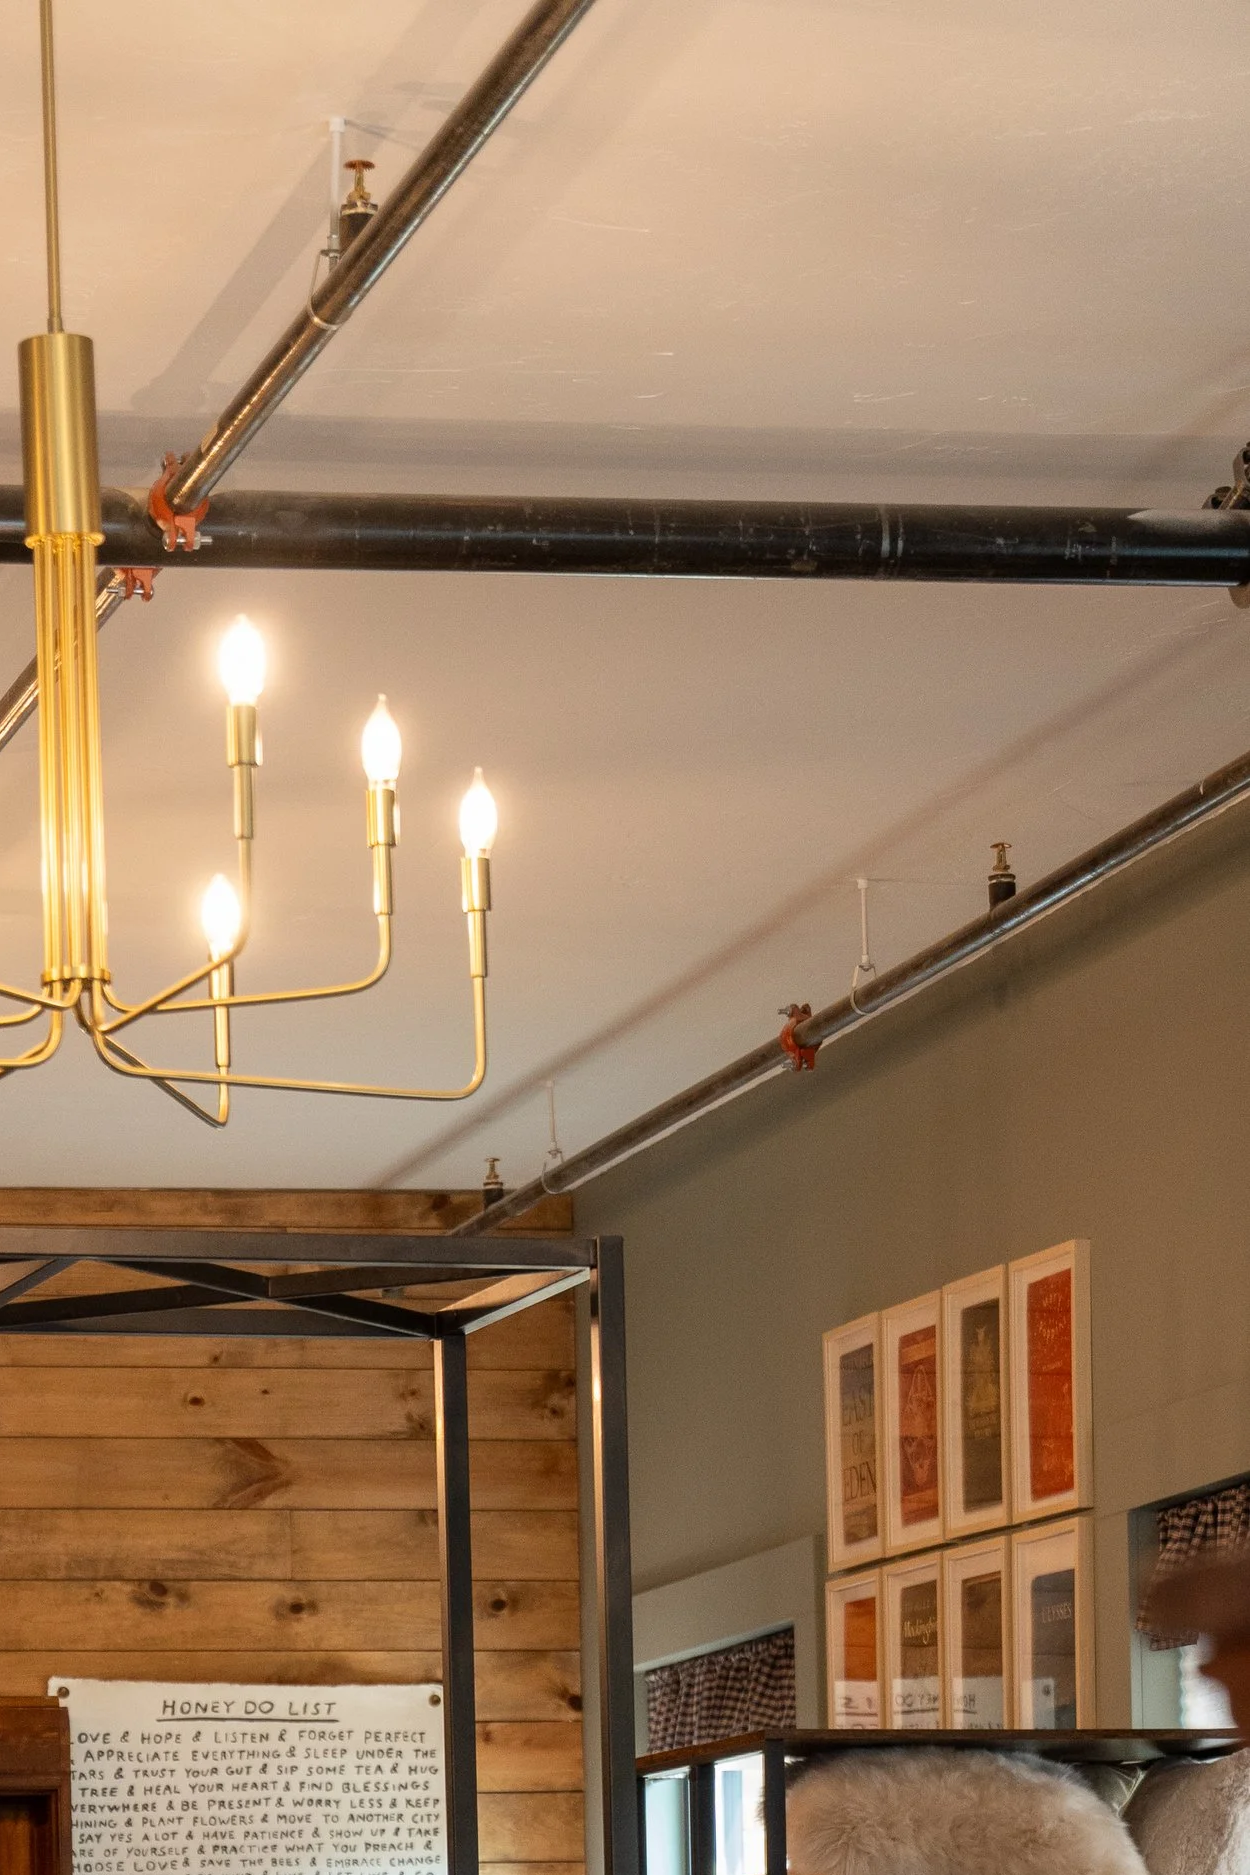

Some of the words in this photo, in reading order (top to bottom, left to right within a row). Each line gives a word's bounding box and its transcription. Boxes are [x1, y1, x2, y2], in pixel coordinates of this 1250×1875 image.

[843, 1459, 877, 1501] EDEN
[163, 1700, 235, 1717] HONEY
[244, 1701, 274, 1715] DO
[289, 1702, 335, 1716] LIST
[120, 1731, 129, 1742] &
[141, 1732, 181, 1744] HOPE
[192, 1731, 201, 1742] &
[214, 1732, 269, 1743] LISTEN
[278, 1729, 286, 1742] &
[299, 1730, 353, 1741] FORGET
[364, 1731, 425, 1743] PERFECT
[84, 1750, 179, 1763] APPRECIATE
[192, 1750, 280, 1761] EVERYTHING
[286, 1747, 295, 1757] &
[305, 1748, 347, 1759] SLEEP
[356, 1748, 402, 1760] UNDER
[414, 1749, 435, 1758] THE
[114, 1767, 123, 1779] &
[133, 1768, 175, 1778] TRUST
[185, 1767, 218, 1778] YOUR
[226, 1766, 252, 1775] GUT
[259, 1763, 267, 1774] &
[277, 1765, 298, 1775] SIP
[307, 1765, 345, 1776] SOME
[355, 1765, 383, 1775] TEA
[390, 1763, 398, 1773] &
[409, 1766, 438, 1775] HUG
[79, 1787, 117, 1797] TREE
[127, 1785, 134, 1796] &
[144, 1785, 180, 1795] HEAL
[189, 1783, 223, 1793] YOUR
[232, 1781, 278, 1791] HEART
[283, 1781, 290, 1791] &
[299, 1781, 333, 1792] FIND
[342, 1781, 429, 1793] BLESSINGS
[167, 1800, 174, 1811] &
[181, 1801, 198, 1811] BE
[208, 1797, 270, 1810] PRESENT
[275, 1797, 284, 1808] &
[293, 1798, 340, 1808] WORRY
[350, 1798, 382, 1809] LESS
[390, 1796, 398, 1808] &
[406, 1798, 439, 1808] KEEP
[124, 1816, 132, 1828] &
[142, 1817, 184, 1827] PLANT
[193, 1815, 253, 1826] FLOWERS
[261, 1814, 268, 1823] &
[277, 1814, 311, 1824] MOVE
[322, 1814, 339, 1824] TO
[348, 1813, 404, 1822] ANOTHER
[412, 1813, 439, 1824] CITY
[79, 1833, 102, 1844] SAY
[110, 1833, 132, 1843] YES
[142, 1831, 150, 1842] A
[155, 1832, 178, 1841] LOT
[186, 1831, 193, 1840] &
[203, 1831, 234, 1840] HAVE
[244, 1829, 303, 1840] PATIENCE
[312, 1827, 320, 1838] &
[329, 1829, 363, 1839] SHOW
[371, 1828, 386, 1838] UP
[394, 1827, 400, 1836] &
[408, 1827, 439, 1839] TAKE
[104, 1848, 118, 1857] OF
[127, 1847, 189, 1858] YOURSELF
[197, 1845, 205, 1854] &
[212, 1845, 277, 1854] PRACTICE
[285, 1843, 324, 1853] WHAT
[332, 1843, 357, 1853] YOU
[365, 1842, 413, 1852] PREACH
[424, 1840, 432, 1850] &
[134, 1860, 177, 1872] LOVE
[182, 1857, 189, 1867] &
[200, 1859, 230, 1868] SAVE
[240, 1858, 263, 1867] THE
[271, 1858, 299, 1867] BEES
[310, 1857, 316, 1867] &
[326, 1858, 380, 1868] EMBRACE
[389, 1855, 440, 1867] CHANGE
